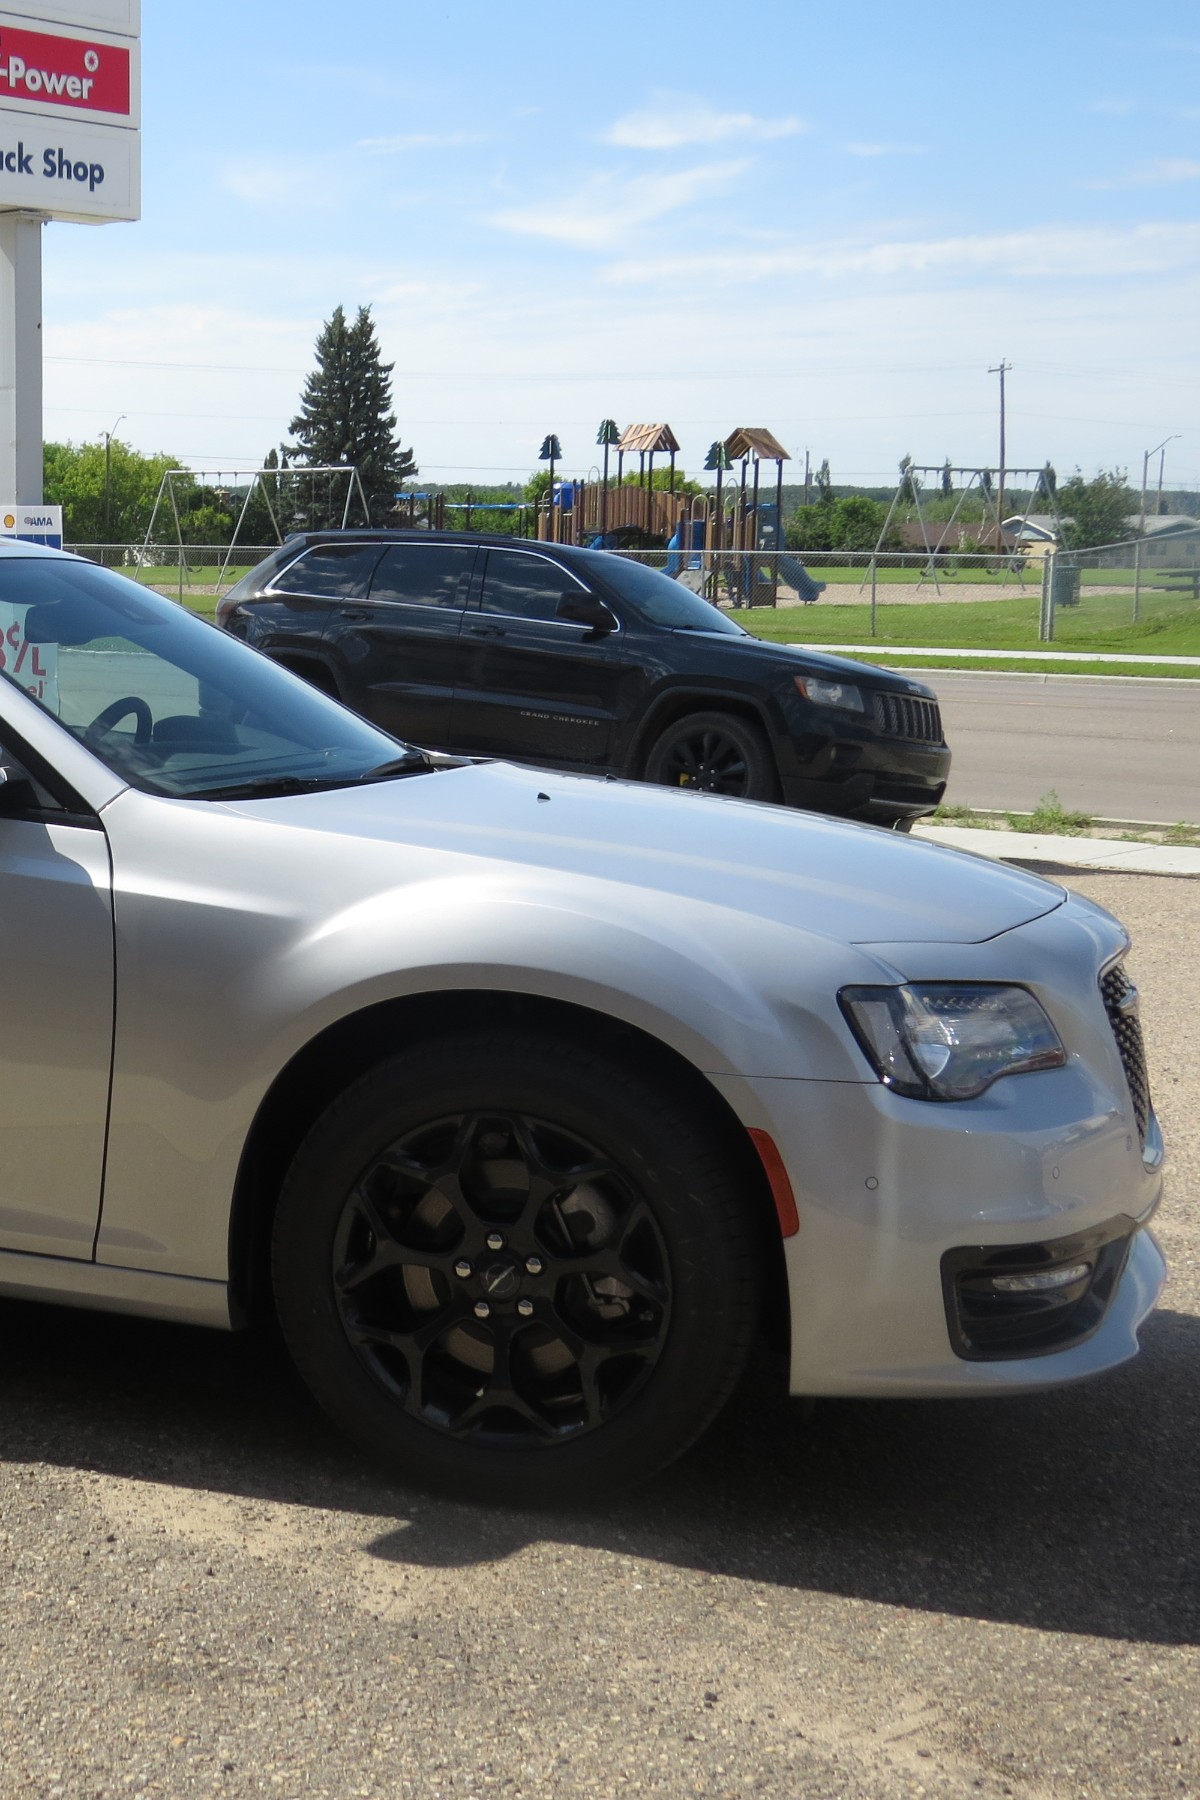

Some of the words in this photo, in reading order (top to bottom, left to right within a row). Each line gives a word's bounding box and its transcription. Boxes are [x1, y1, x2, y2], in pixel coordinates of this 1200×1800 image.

[43, 148, 104, 191] Shop
[30, 517, 53, 527] AMA
[26, 680, 44, 699] el
[520, 710, 550, 719] GRAND
[552, 715, 600, 726] CHEROKEE
